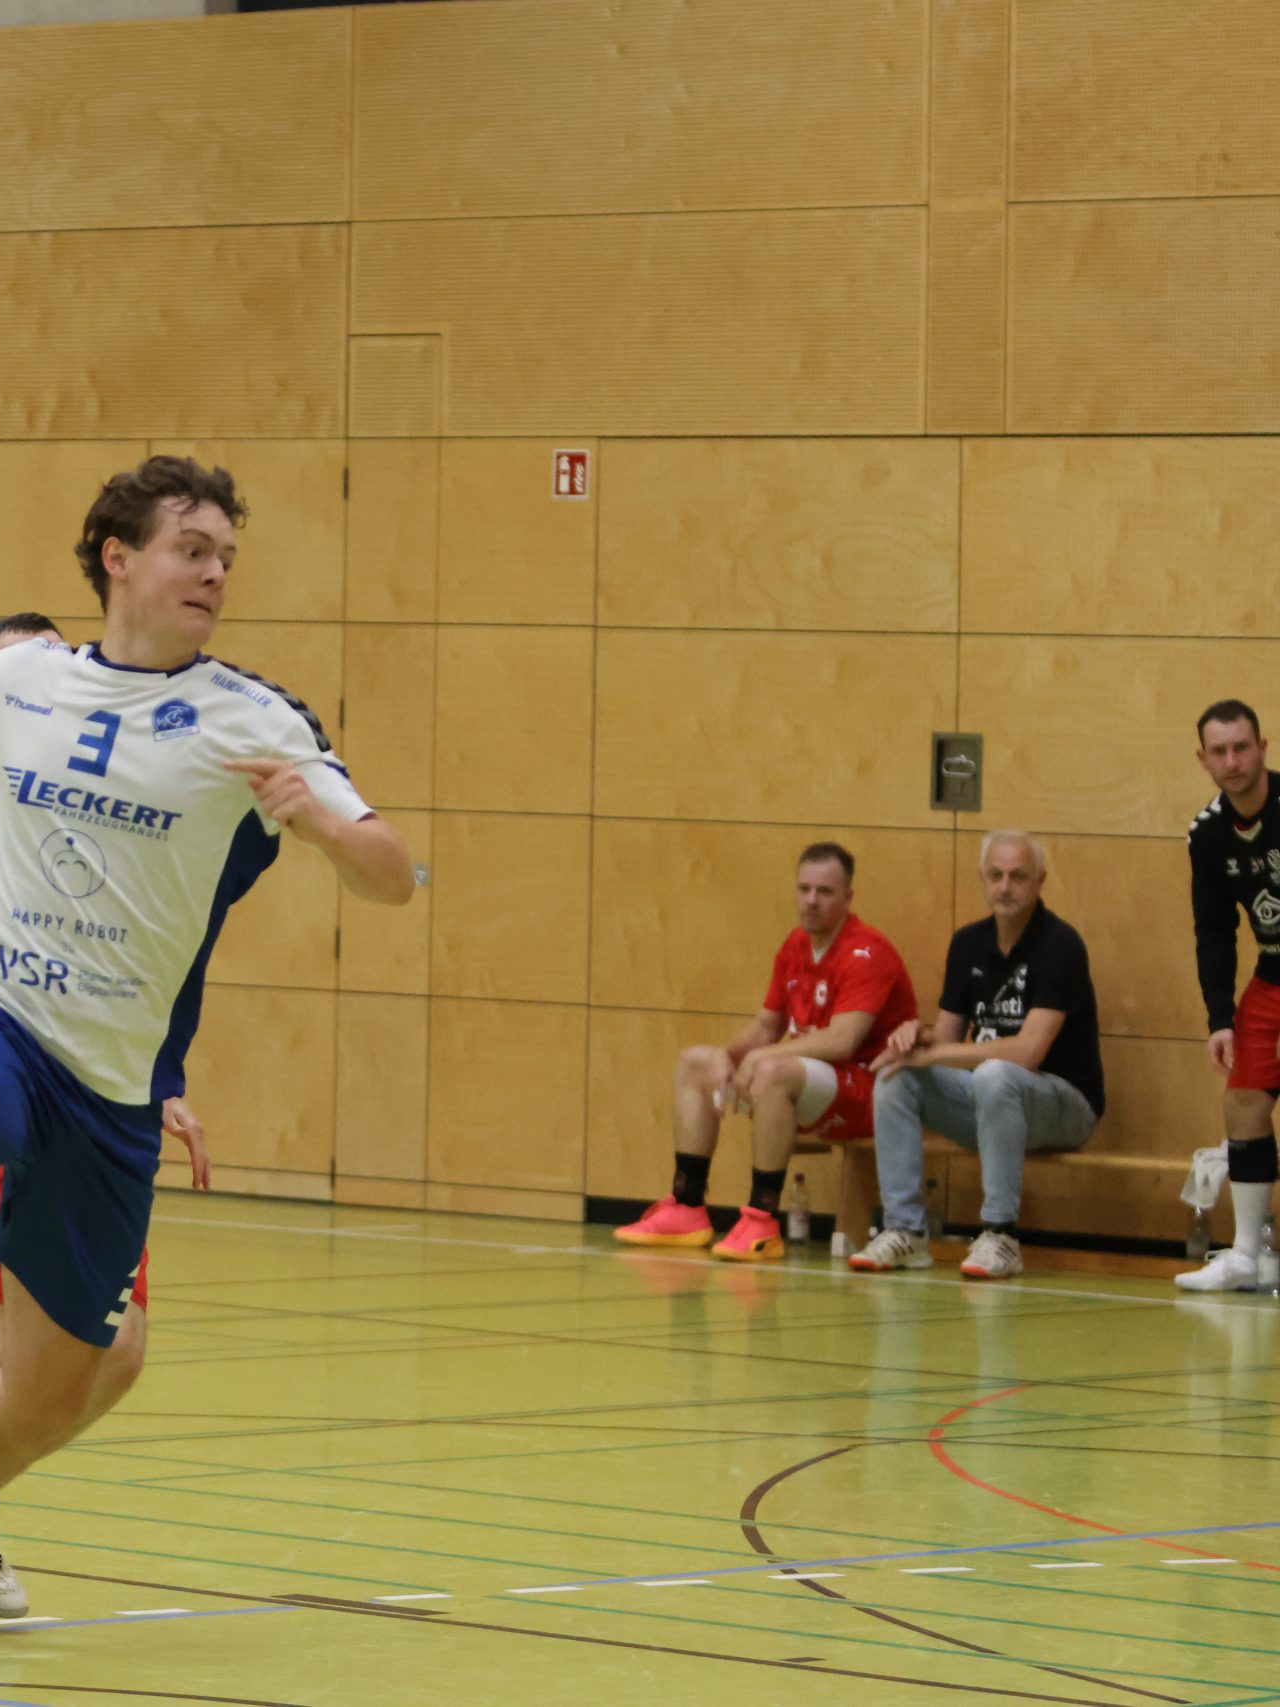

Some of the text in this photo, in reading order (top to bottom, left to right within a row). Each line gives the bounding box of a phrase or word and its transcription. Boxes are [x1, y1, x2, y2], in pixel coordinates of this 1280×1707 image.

[67, 710, 122, 778] 3
[17, 769, 184, 831] LECKERT
[53, 806, 169, 842] FAHRZEUGHANDEL
[13, 908, 128, 943] HAPPY ROBOT
